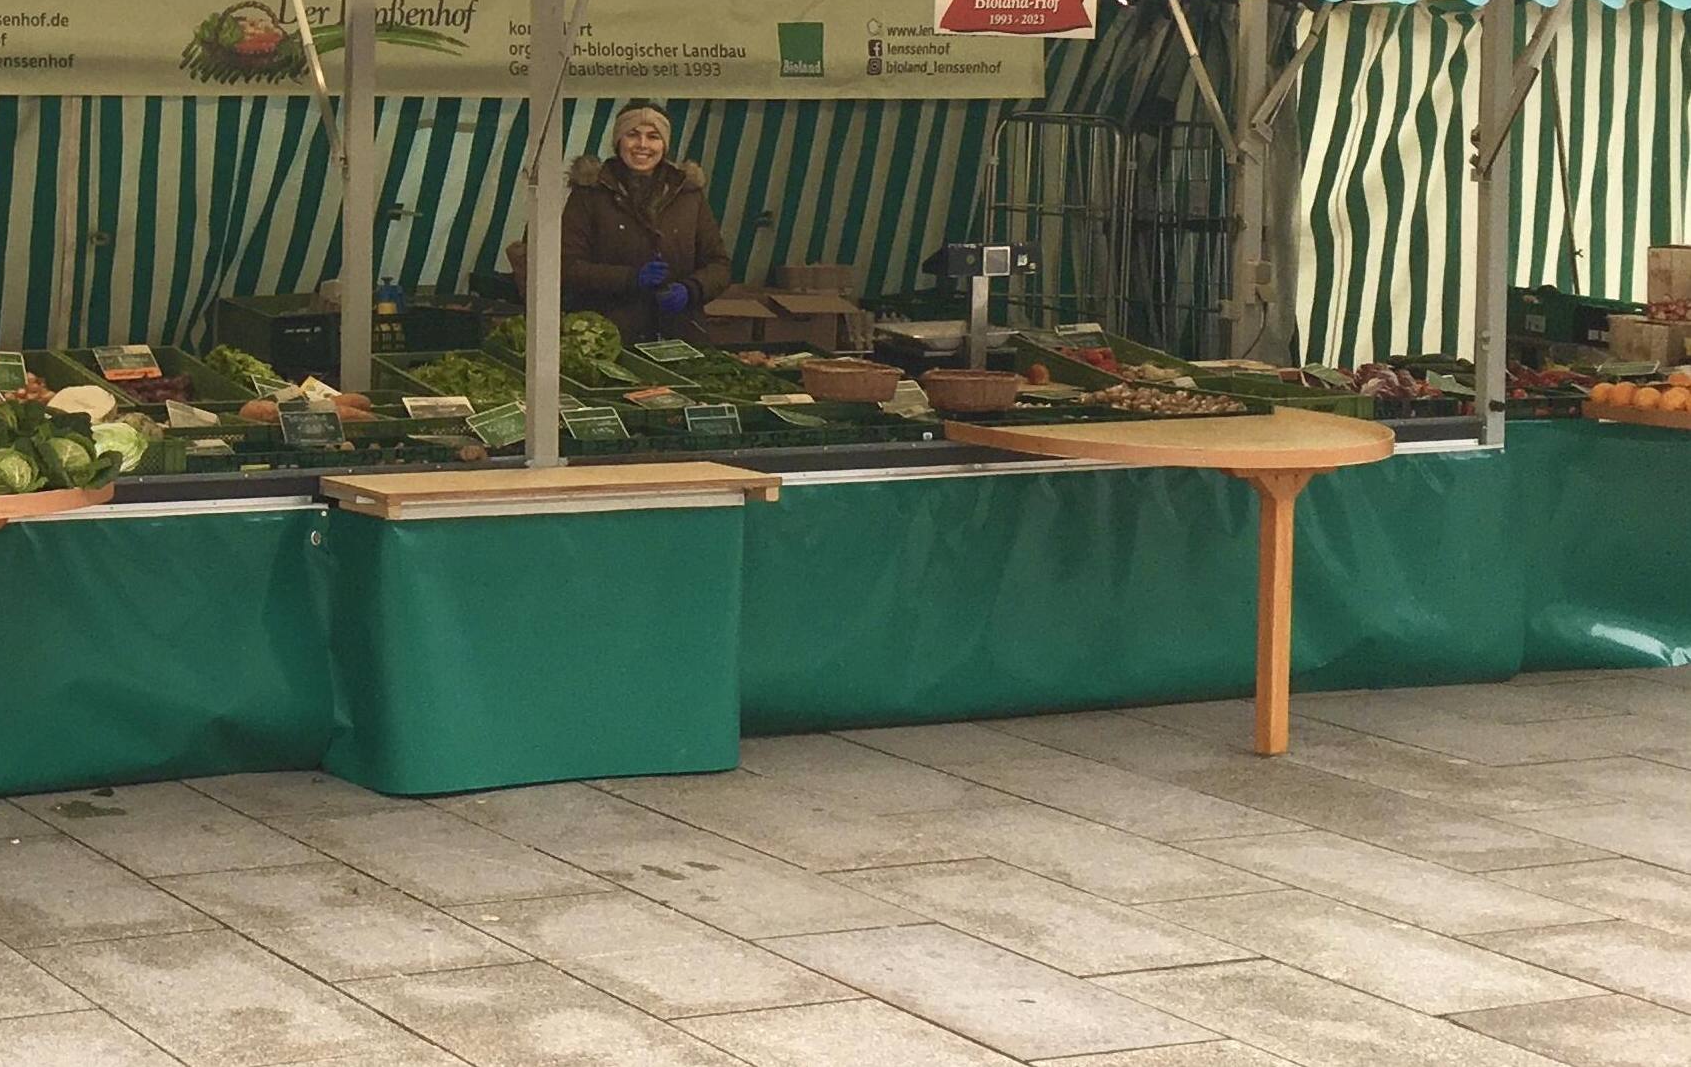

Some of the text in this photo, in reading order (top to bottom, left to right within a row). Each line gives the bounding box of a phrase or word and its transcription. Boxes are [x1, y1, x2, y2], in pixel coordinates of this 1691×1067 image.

[990, 14, 1012, 25] 1993
[1021, 14, 1045, 24] 2023
[509, 42, 747, 60] orgh-biologischer Landbau
[887, 42, 951, 55] lenssenhof
[509, 61, 722, 77] Gebaubetrieb seit 1993
[886, 60, 1002, 76] bioland_lenssenhof
